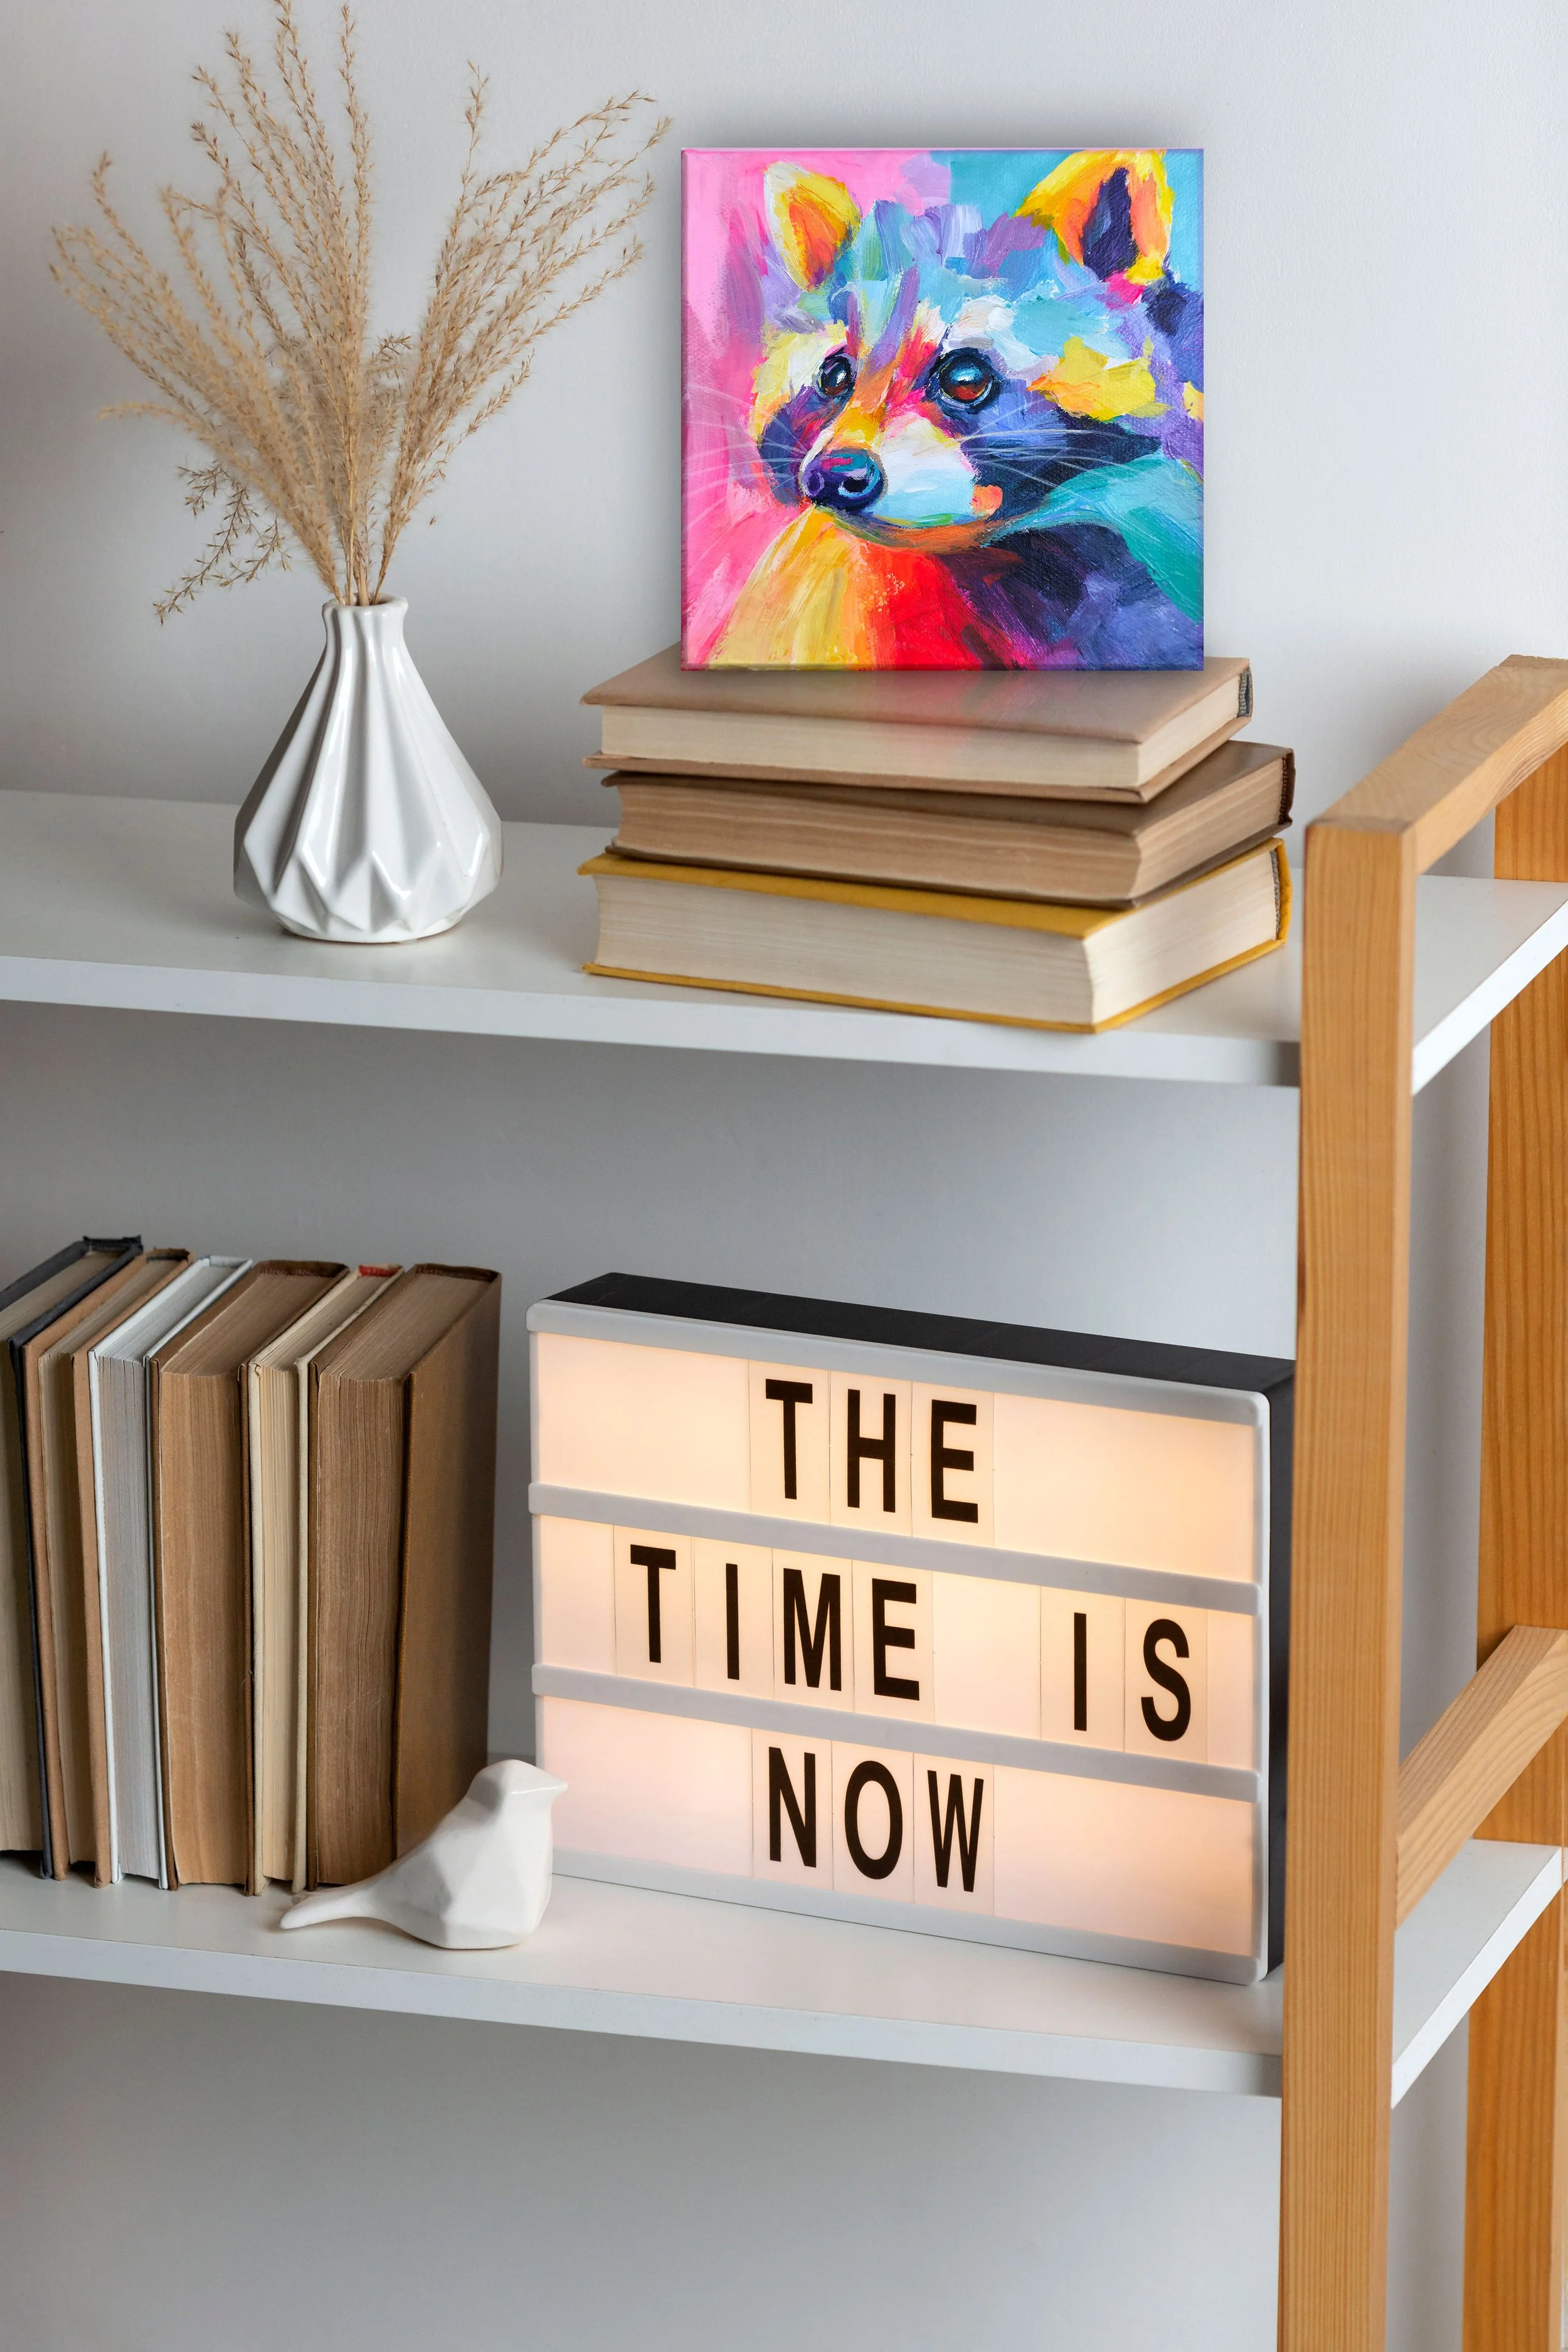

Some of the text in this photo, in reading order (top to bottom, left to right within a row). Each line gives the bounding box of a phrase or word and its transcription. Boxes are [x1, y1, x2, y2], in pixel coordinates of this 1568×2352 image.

[765, 1378, 978, 1524] THE
[630, 1544, 1191, 1742] TIME IS
[768, 1746, 984, 1893] NOW
